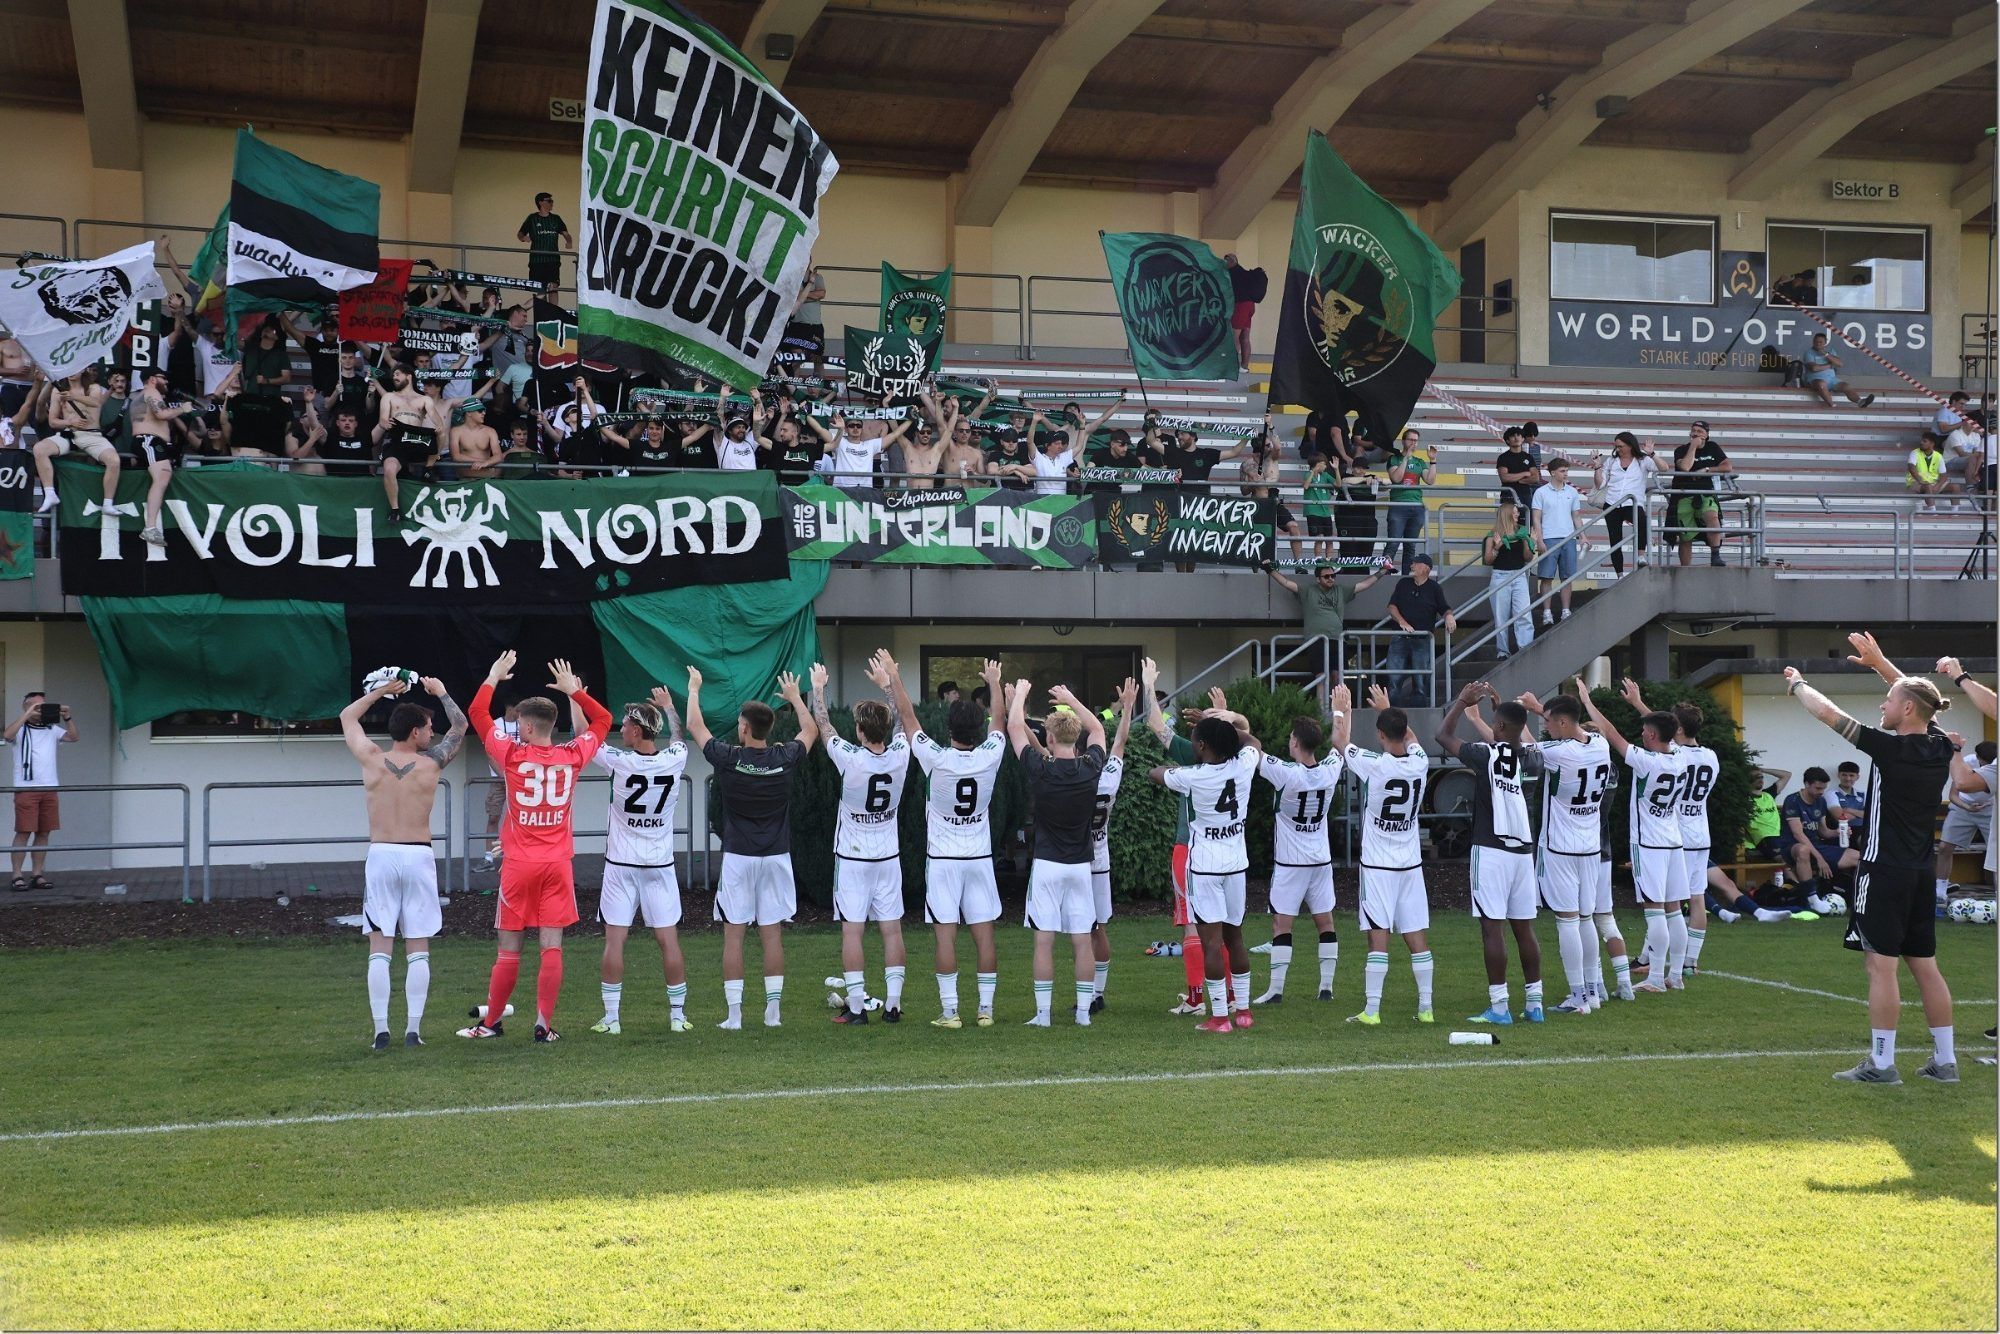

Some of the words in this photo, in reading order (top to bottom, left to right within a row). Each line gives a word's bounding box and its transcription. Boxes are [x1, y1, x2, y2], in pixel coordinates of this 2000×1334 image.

[551, 101, 586, 118] Sek
[594, 8, 832, 219] KEINEN
[588, 119, 809, 284] SCHRITT
[1834, 181, 1883, 199] Sektor
[1888, 182, 1900, 200] B
[1322, 228, 1400, 281] WACKER
[483, 275, 542, 289] WACKER
[1133, 272, 1206, 310] WACKER
[888, 291, 914, 311] WACKER
[398, 328, 461, 343] COMMANDO
[1138, 298, 1224, 347] INVENTAR
[1556, 310, 1926, 350] WORLD-OF-JOBS
[404, 338, 452, 352] GIESSEN
[1640, 348, 1689, 365] STARKE
[1693, 349, 1727, 367] JOBS
[1731, 350, 1755, 367] FÜR
[1759, 350, 1793, 367] GUTE
[876, 354, 914, 372] 1913
[811, 402, 908, 420] UNTERLAND
[1155, 416, 1195, 430] WACKER
[1211, 423, 1259, 437] INVENTAR
[1079, 468, 1118, 481] WACKER
[1134, 469, 1179, 482] INVENTAR
[886, 489, 962, 508] Aspirante
[1180, 495, 1257, 529] WACKER
[82, 499, 376, 567] TIVOLI
[537, 495, 762, 569] NORD
[818, 500, 1053, 550] UNTERLAND
[1169, 527, 1265, 561] INVENTAR
[1279, 556, 1318, 566] WACKER
[1337, 555, 1387, 566] INVENTAR
[515, 763, 572, 808] 30
[624, 774, 674, 814] 27
[865, 773, 892, 813] 6
[953, 777, 978, 817] 9
[1215, 778, 1239, 820] 4
[1380, 778, 1422, 821] 21
[1570, 764, 1609, 805] 13
[1682, 764, 1713, 802] 18
[519, 809, 563, 826] BALLIS
[627, 817, 665, 828] RACKL
[1292, 789, 1326, 824] 11
